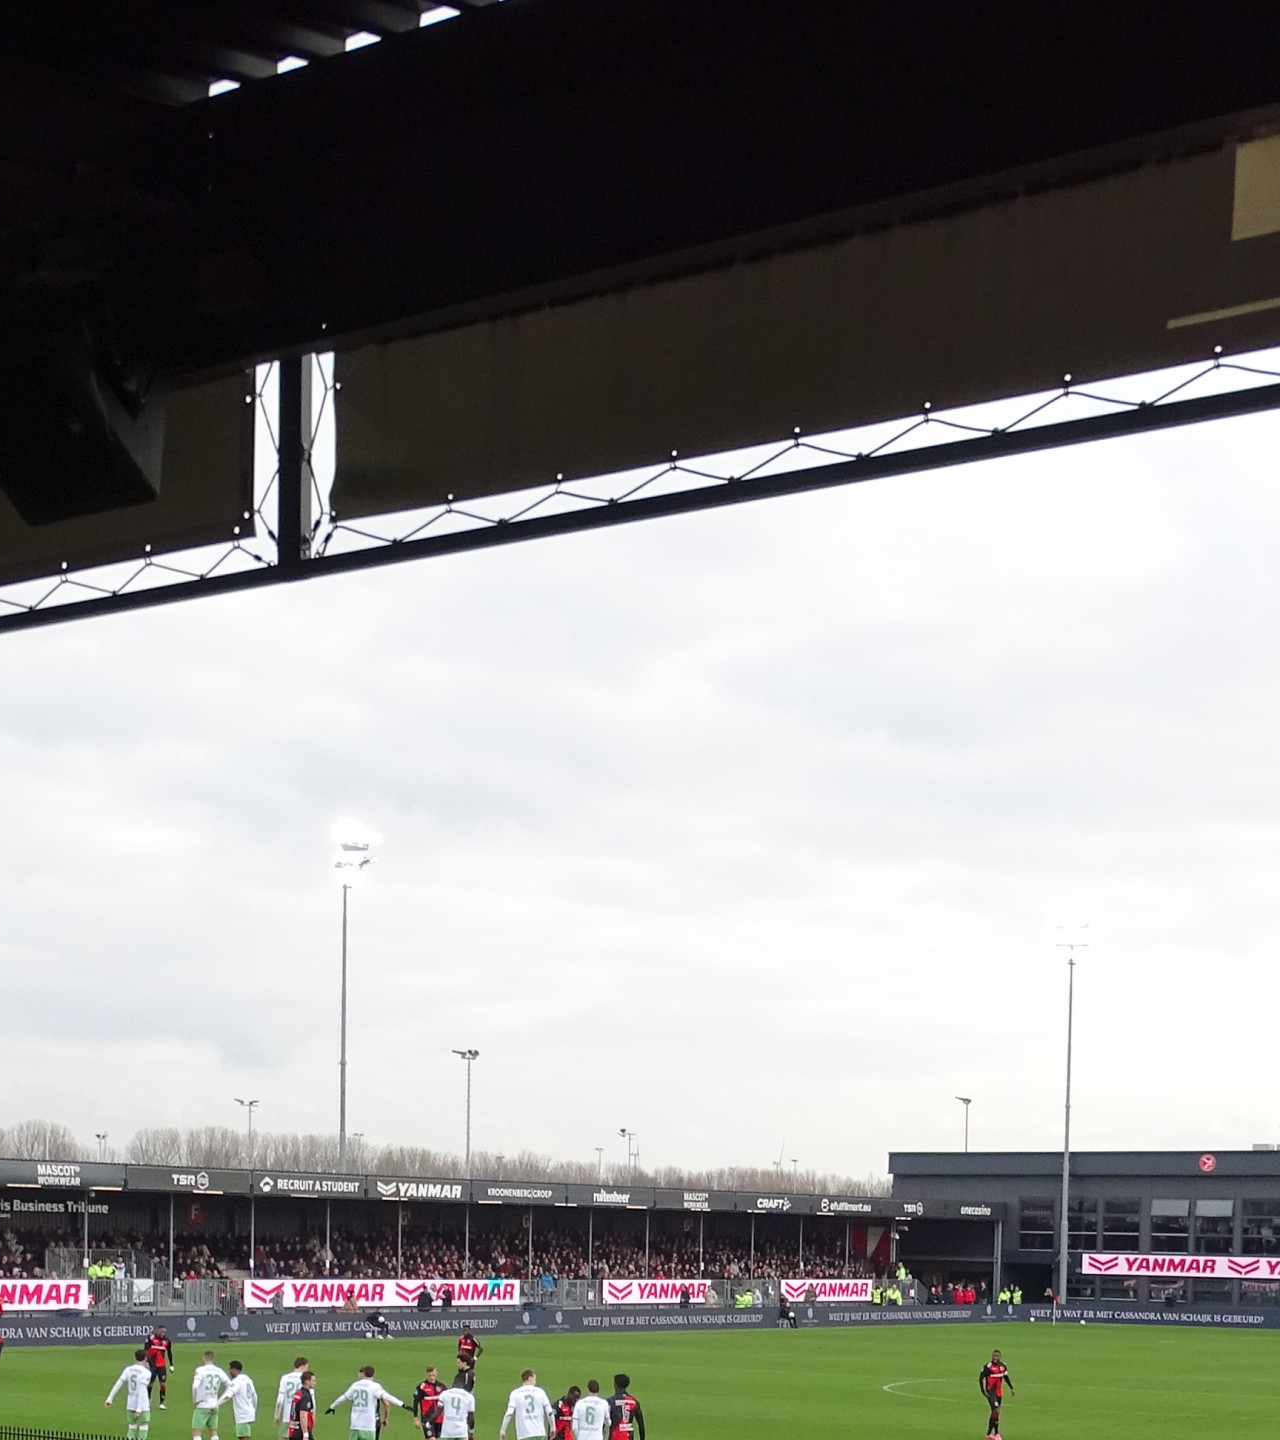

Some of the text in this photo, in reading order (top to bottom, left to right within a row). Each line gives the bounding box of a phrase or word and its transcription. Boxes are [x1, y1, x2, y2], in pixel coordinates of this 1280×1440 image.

[37, 1176, 81, 1187] WORKWEAR
[172, 1174, 196, 1186] TSR
[277, 1178, 360, 1193] RECRUIT A STUDENT
[398, 1182, 463, 1199] YANMAR
[13, 1199, 65, 1213] Business
[756, 1198, 785, 1209] CRAFT
[960, 1204, 992, 1216] onecasino
[1124, 1257, 1217, 1274] YANMAR
[291, 1283, 385, 1302] YANMAR
[637, 1282, 708, 1300] YANMAR
[812, 1282, 869, 1298] YANMAR
[582, 1316, 601, 1326] WEET
[610, 1315, 626, 1326] WAT
[626, 1315, 636, 1325] ER
[636, 1315, 649, 1325] MET
[650, 1314, 687, 1326] CASSANDRA
[688, 1314, 702, 1325] VAN
[1030, 1309, 1052, 1318] WEET
[1063, 1310, 1082, 1318] WAT
[1083, 1310, 1095, 1318] ER
[1096, 1310, 1113, 1319] MET
[1114, 1311, 1161, 1321] CASSANDRA
[1162, 1312, 1179, 1322] VAN
[1213, 1314, 1221, 1323] IS
[1222, 1314, 1264, 1324] GEBEURD?
[26, 1327, 48, 1340] VAN
[50, 1325, 91, 1340] SCHAIJK
[93, 1325, 103, 1337] IS
[105, 1324, 154, 1338] GEBEURD?
[266, 1322, 290, 1333] WEET
[302, 1321, 322, 1333] WAT
[322, 1321, 334, 1332] ER
[335, 1320, 352, 1332] MET
[403, 1320, 420, 1331] VAN
[420, 1319, 451, 1332] SCHAIJK
[452, 1319, 459, 1330] IS
[460, 1319, 499, 1330] GEBEURD?
[352, 1389, 368, 1408] 29
[450, 1398, 461, 1415] 4
[524, 1394, 535, 1414] 3
[585, 1405, 596, 1425] 6
